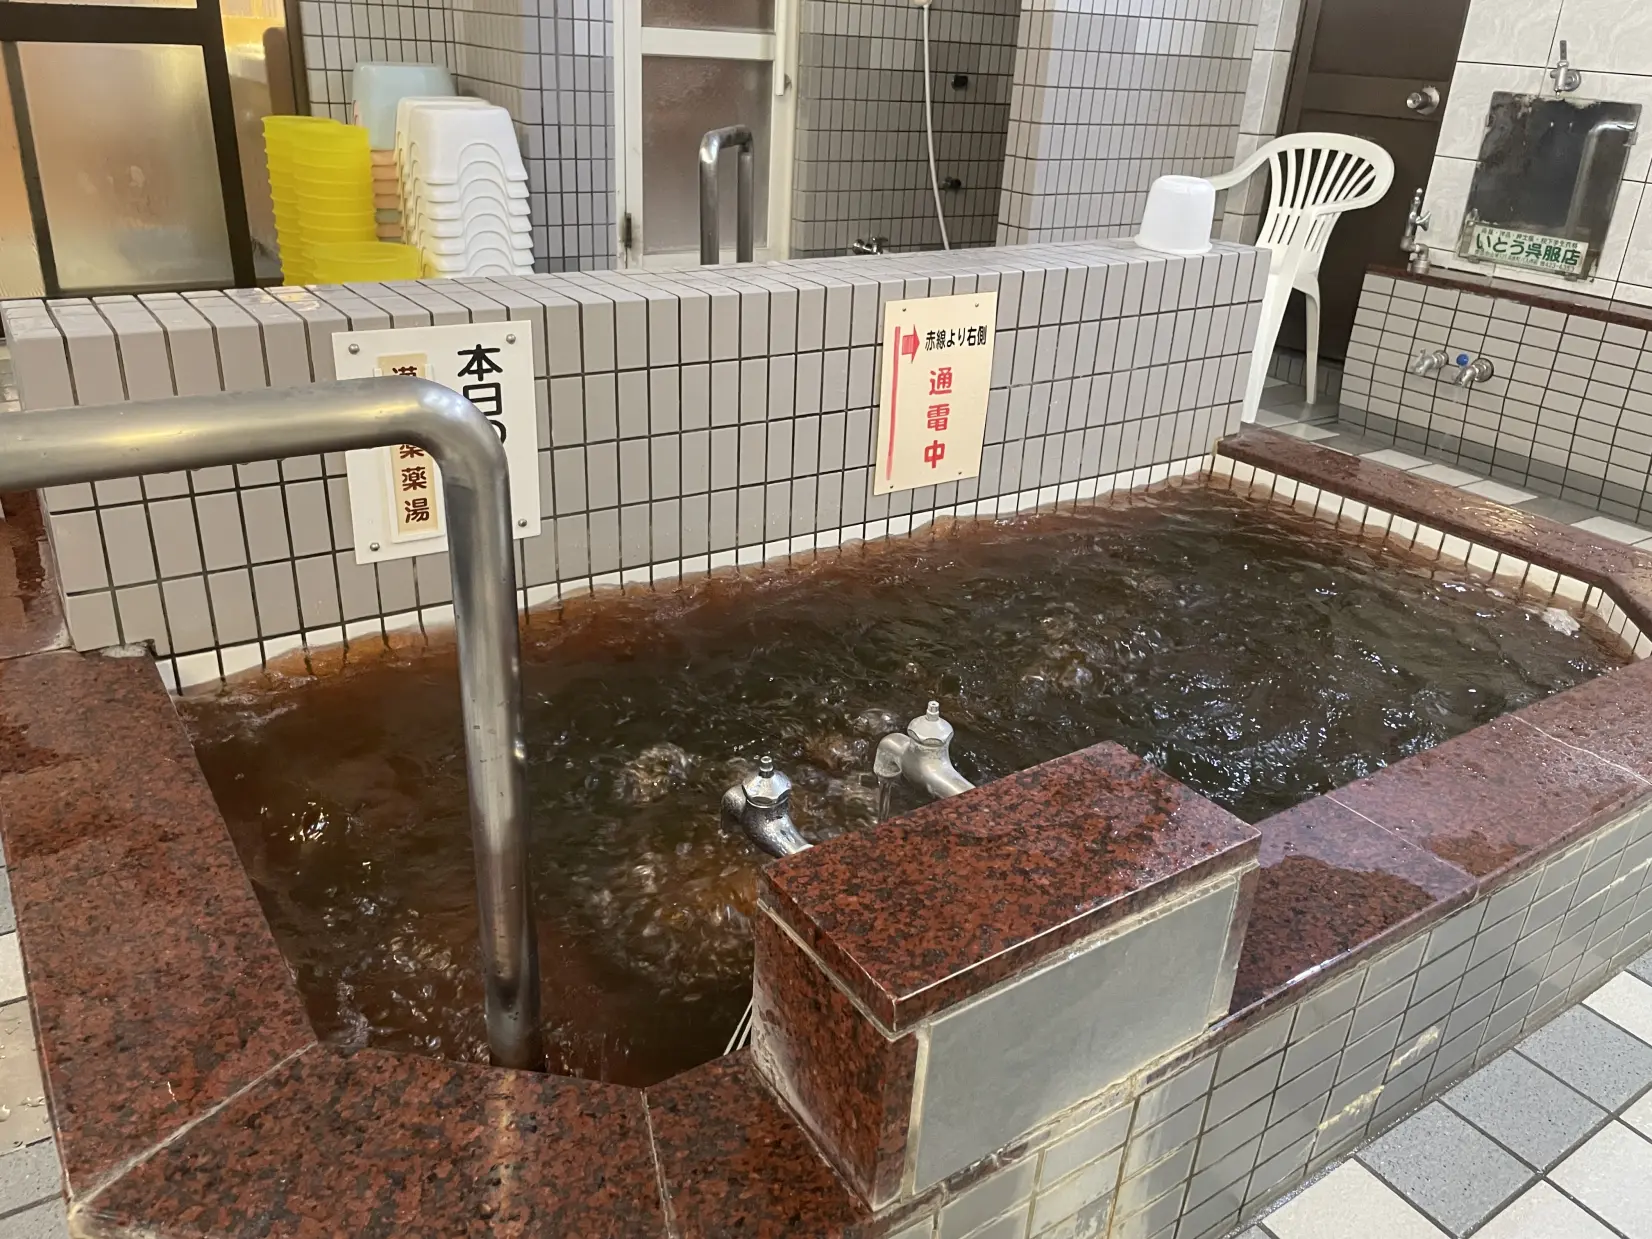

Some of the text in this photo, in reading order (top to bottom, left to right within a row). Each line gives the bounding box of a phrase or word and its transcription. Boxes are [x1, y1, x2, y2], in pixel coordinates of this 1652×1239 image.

[1476, 233, 1582, 266] いとう呉服店
[925, 325, 988, 351] 赤線より右側
[924, 367, 953, 469] 通電中
